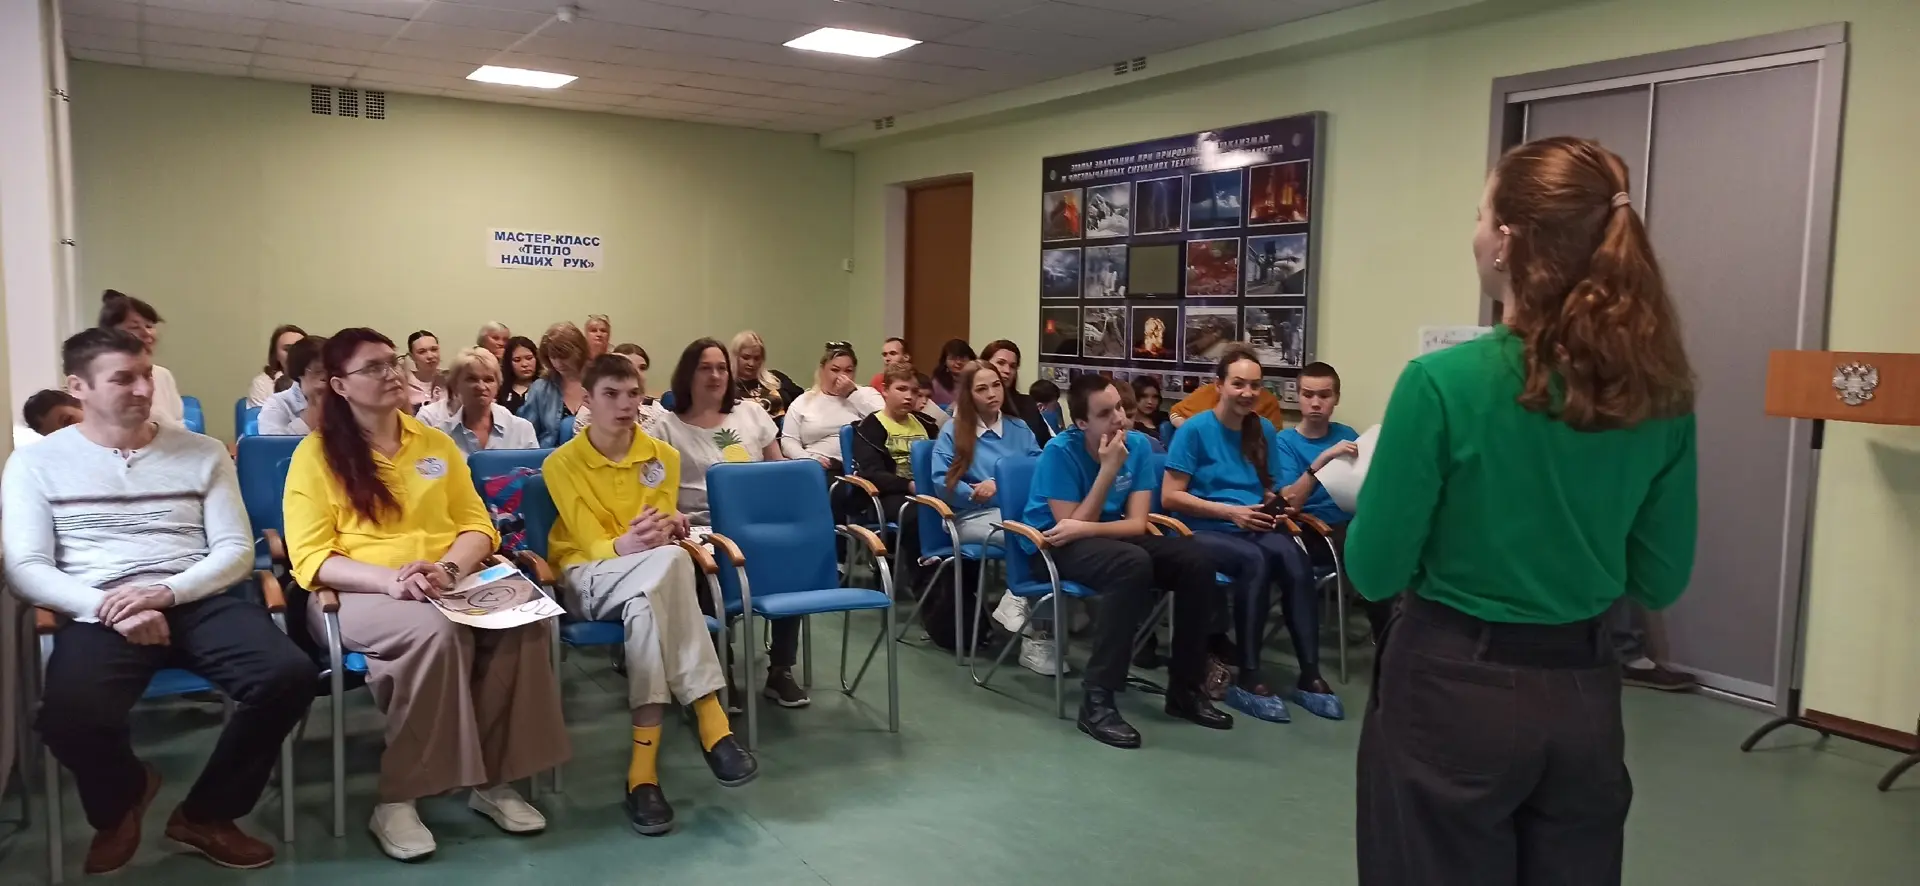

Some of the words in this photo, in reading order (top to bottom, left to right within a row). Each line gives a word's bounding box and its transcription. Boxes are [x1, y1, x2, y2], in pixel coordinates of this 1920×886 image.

[494, 231, 600, 247] МАСТЕР-КЛАСС
[518, 244, 571, 256] «ТЕПЛО
[501, 254, 553, 267] НАШИХ
[563, 258, 595, 269] РУК»
